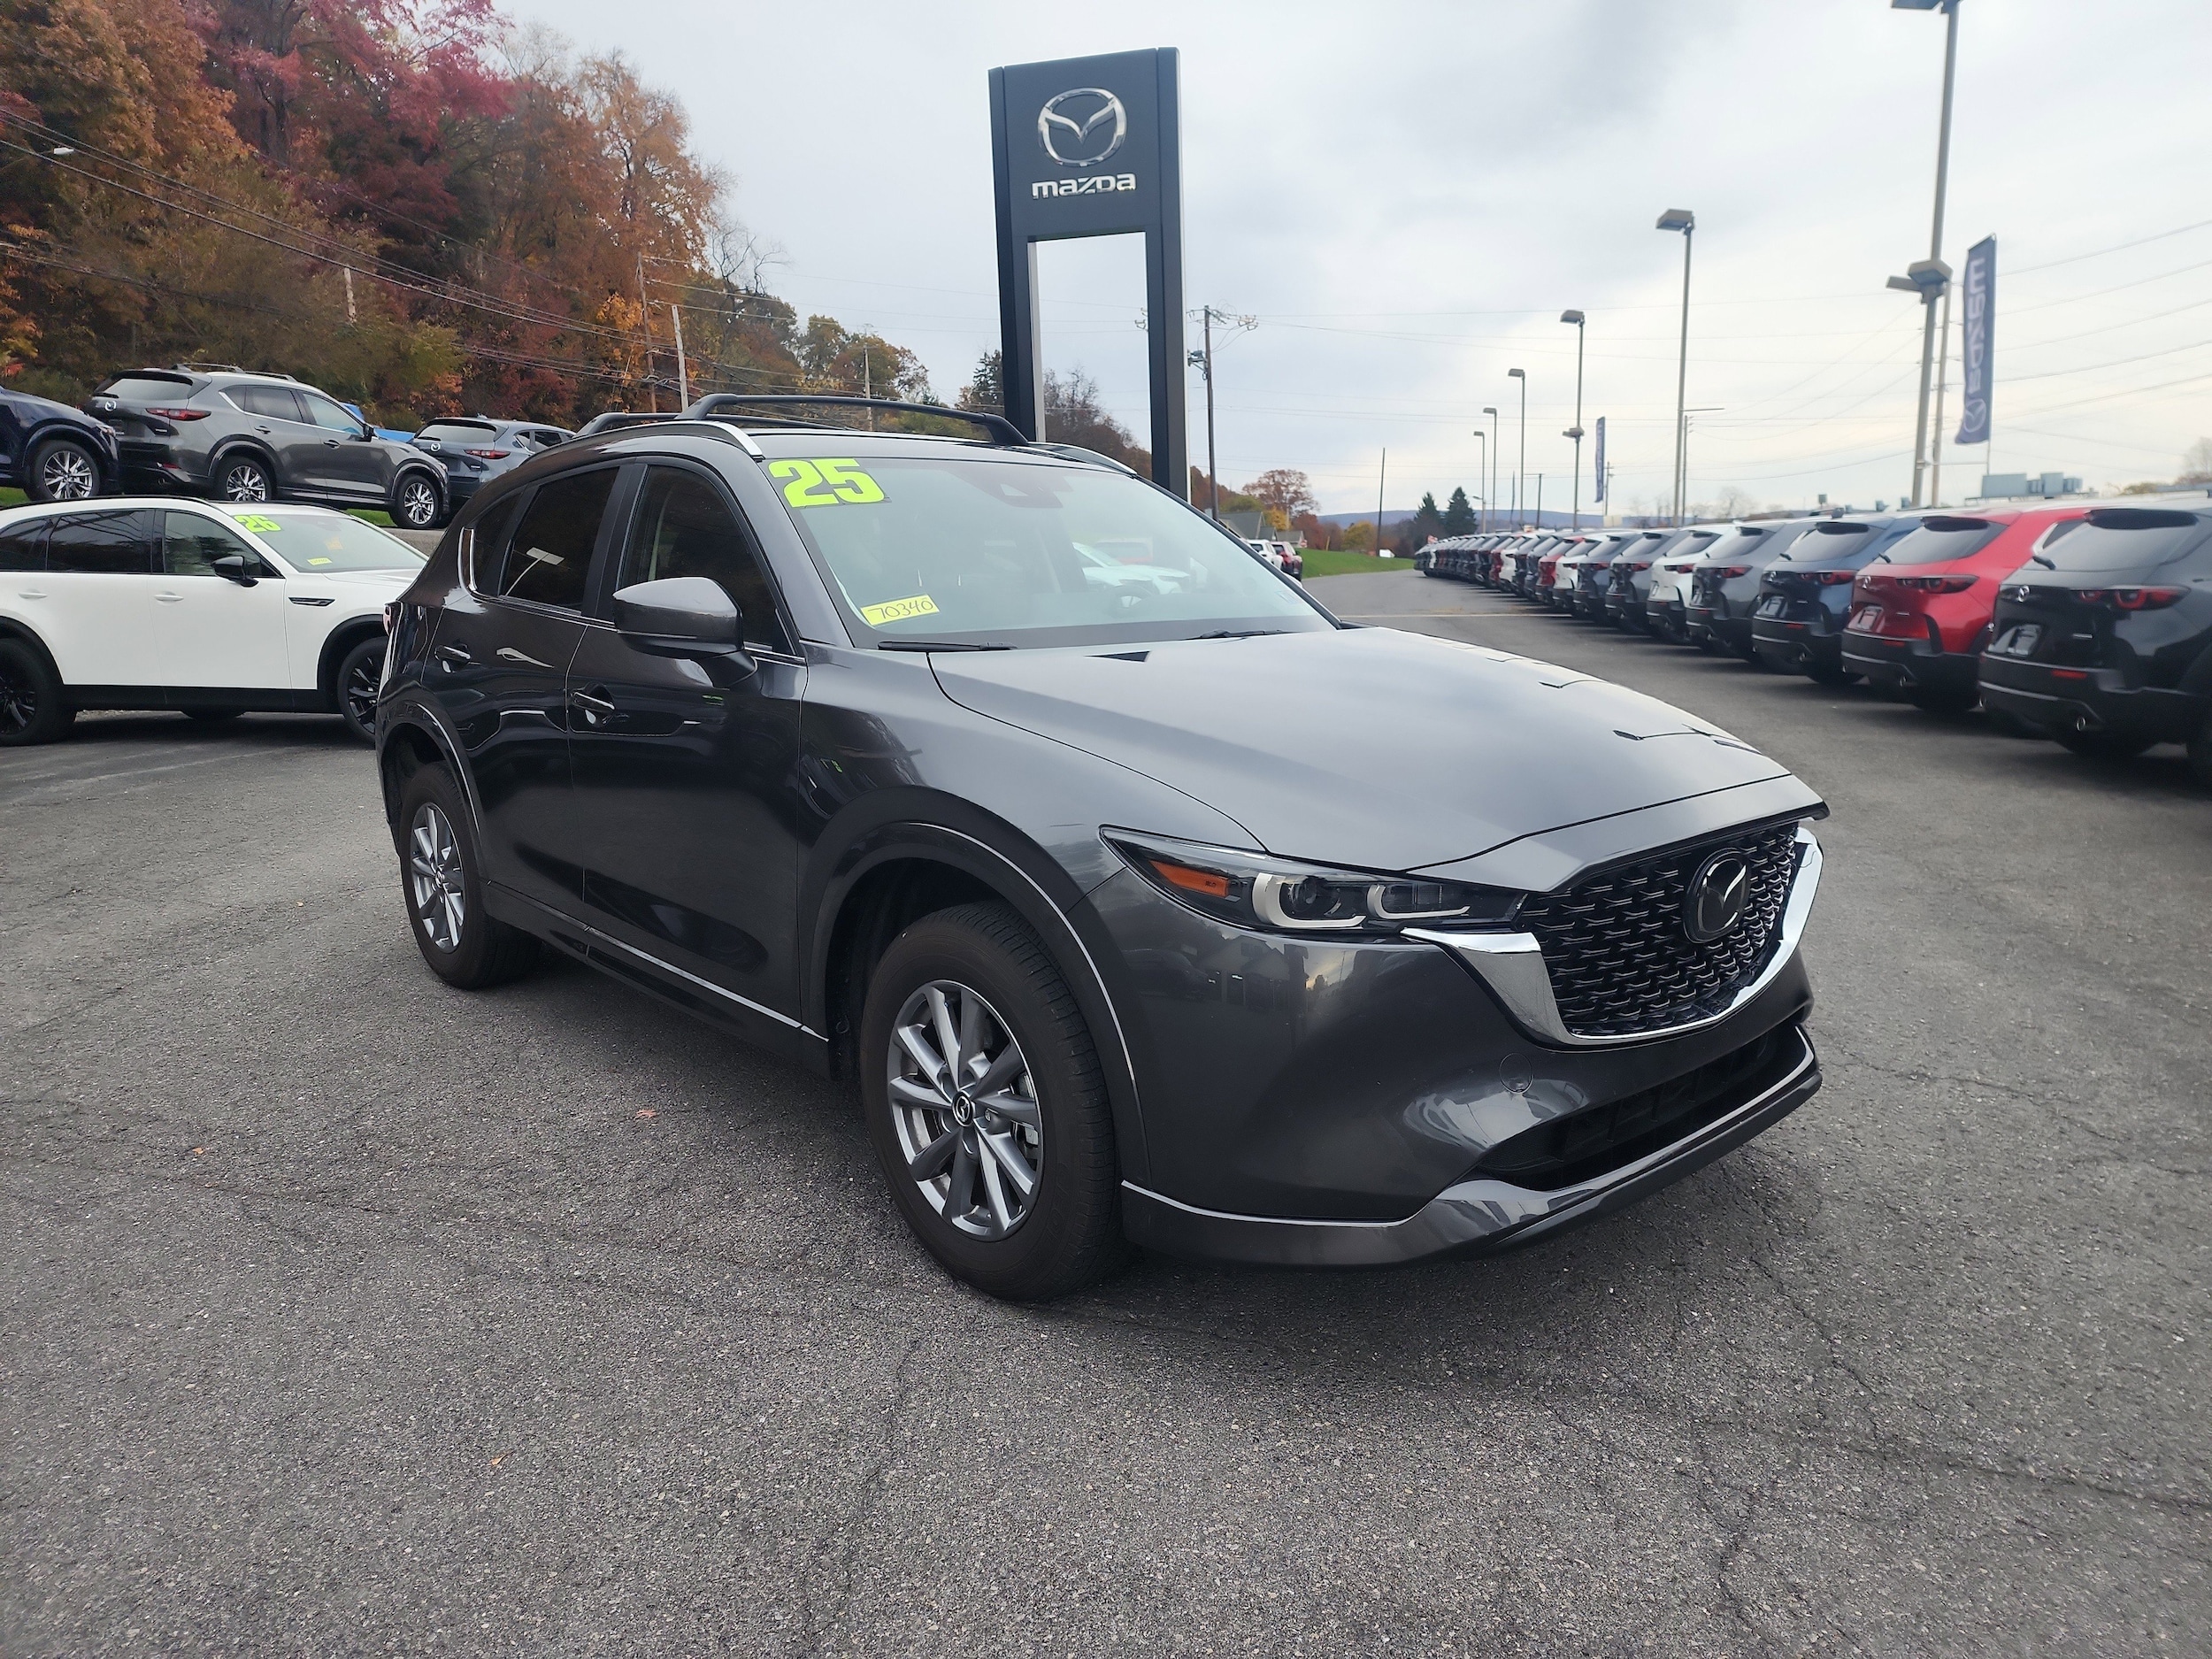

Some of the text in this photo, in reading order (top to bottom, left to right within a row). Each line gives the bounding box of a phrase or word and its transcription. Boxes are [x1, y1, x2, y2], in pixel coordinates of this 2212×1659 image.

[1032, 173, 1137, 199] mazda
[768, 457, 886, 508] 25
[233, 514, 282, 533] 26
[867, 599, 934, 619] 70340
